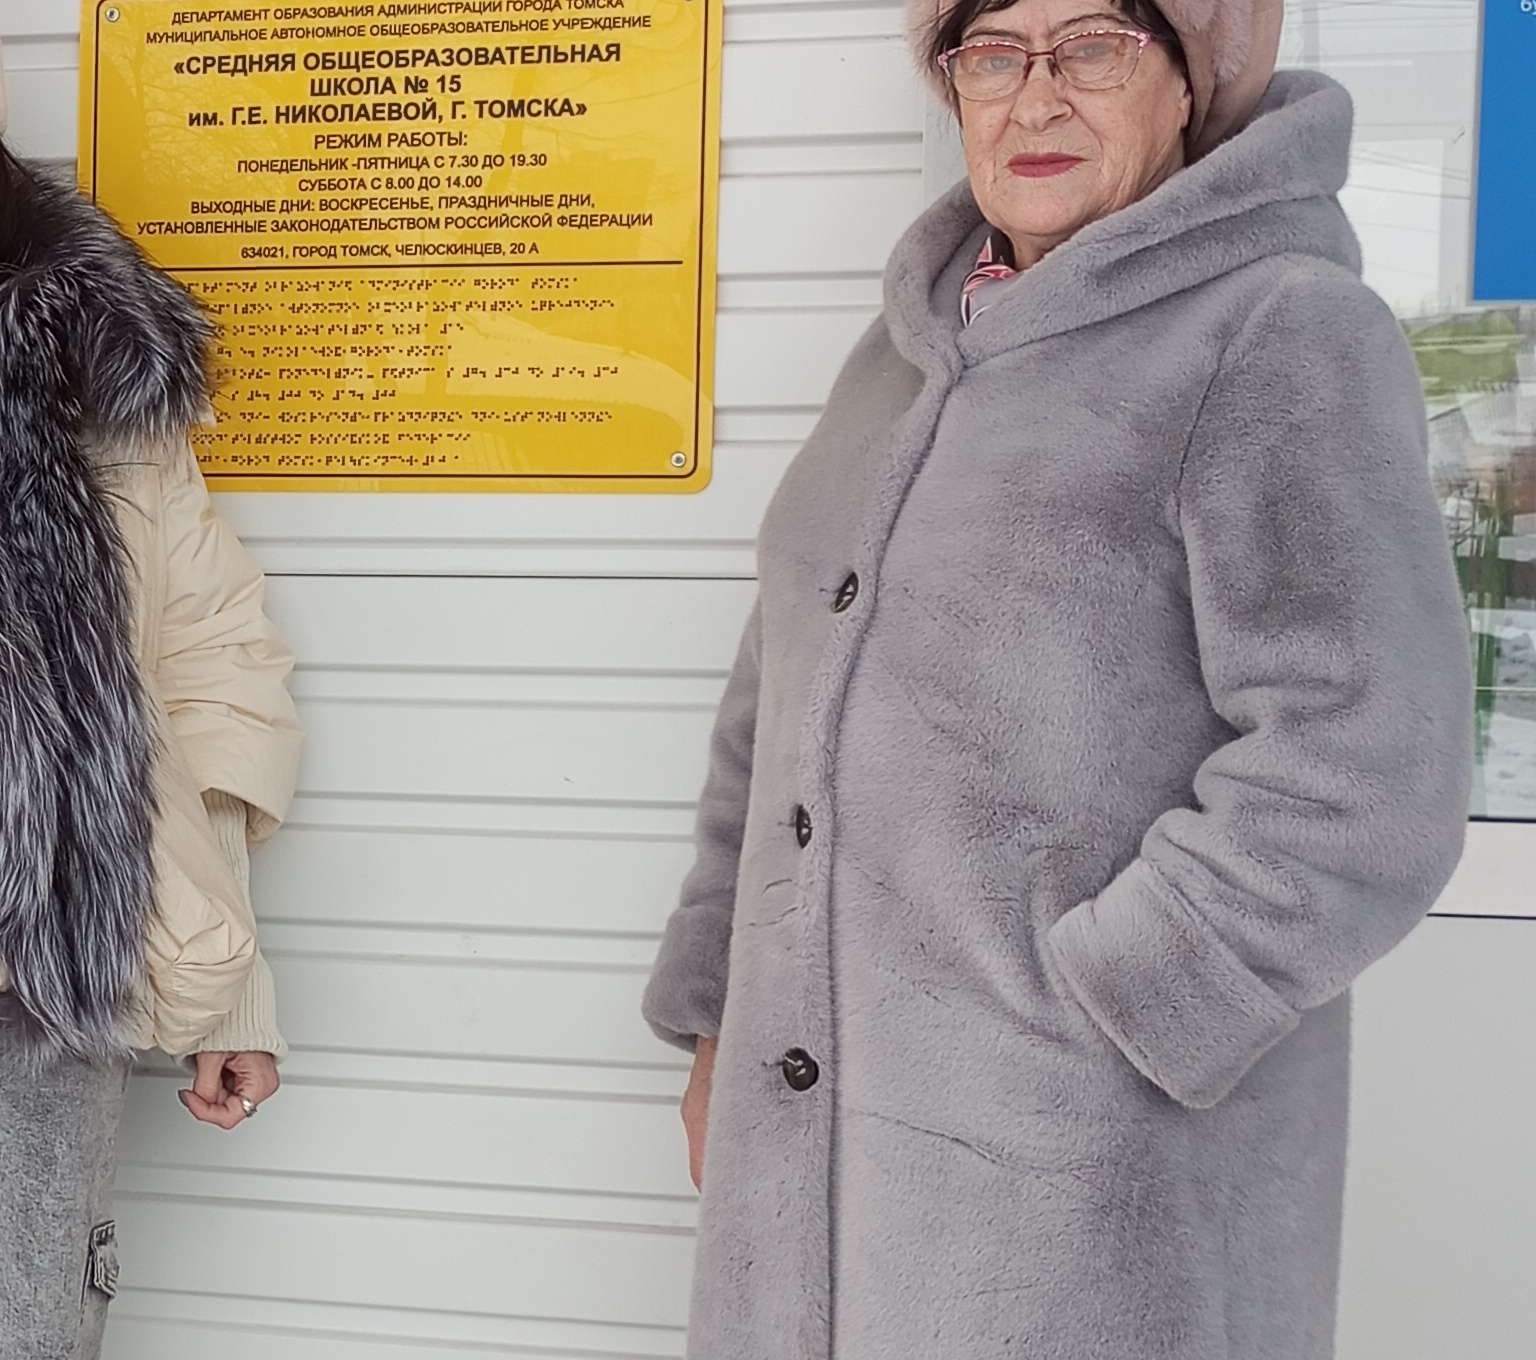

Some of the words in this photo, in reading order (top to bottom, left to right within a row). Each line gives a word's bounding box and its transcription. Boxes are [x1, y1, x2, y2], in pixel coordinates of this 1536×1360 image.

[172, 9, 270, 25] ДЕПАРТАМЕНТ
[274, 5, 374, 20] ОБРАЗОВАНИЯ
[377, 1, 502, 18] АДМИНИСТРАЦИИ
[506, 0, 562, 12] ГОРОДА
[146, 28, 267, 45] МУНИЦИПАЛЬНОЕ
[271, 25, 366, 39] АВТОНОМНОЕ
[370, 19, 548, 37] ОБЩЕОБРАЗОВАТЕЛЬНОЕ
[552, 16, 651, 31] УЧРЕЖДЕНИЕ
[174, 53, 295, 77] «СРЕДНЯЯ
[303, 43, 620, 73] ОБЩЕОБРАЗОВАТЕЛЬНАЯ
[311, 77, 396, 96] ШКОЛА
[405, 76, 428, 94] №
[437, 74, 461, 93] 15
[189, 113, 223, 126] им.
[232, 106, 267, 125] Г.Е.
[275, 98, 442, 124] НИКОЛАЕВОЙ,
[451, 101, 466, 119] Г.
[474, 98, 587, 118] ТОМСКА»
[315, 133, 381, 149] РЕЖИМ
[387, 131, 467, 147] РАБОТЫ:
[238, 158, 348, 174] ПОНЕДЕЛЬНИК
[352, 156, 430, 171] -ПЯТНИЦА
[434, 156, 444, 168] С
[449, 155, 478, 167] 7.30
[482, 155, 504, 169] ДО
[510, 154, 547, 166] 19.30
[299, 178, 367, 191] СУББОТА
[371, 177, 381, 190] С
[386, 177, 414, 189] 8.00
[418, 176, 440, 191] ДО
[446, 176, 482, 188] 14.00
[191, 200, 276, 215] ВЫХОДНЫЕ
[279, 199, 314, 214] ДНИ:
[319, 197, 433, 211] ВОСКРЕСЕНЬЕ,
[438, 194, 553, 210] ПРАЗДНИЧНЫЕ
[557, 194, 594, 209] ДНИ,
[137, 220, 267, 235] УСТАНОВЛЕННЫЕ
[271, 217, 440, 234] ЗАКОНОДАТЕЛЬСТВОМ
[445, 213, 552, 229] РОССИЙСКОЙ
[557, 214, 652, 229] ФЕДЕРАЦИИ
[241, 247, 288, 259] 634021,
[293, 246, 337, 259] ГОРОД
[340, 245, 391, 257] ТОМСК,
[396, 243, 505, 257] ЧЕЛЮСКИНЦЕВ,
[510, 243, 525, 254] 20
[529, 242, 539, 254] А
